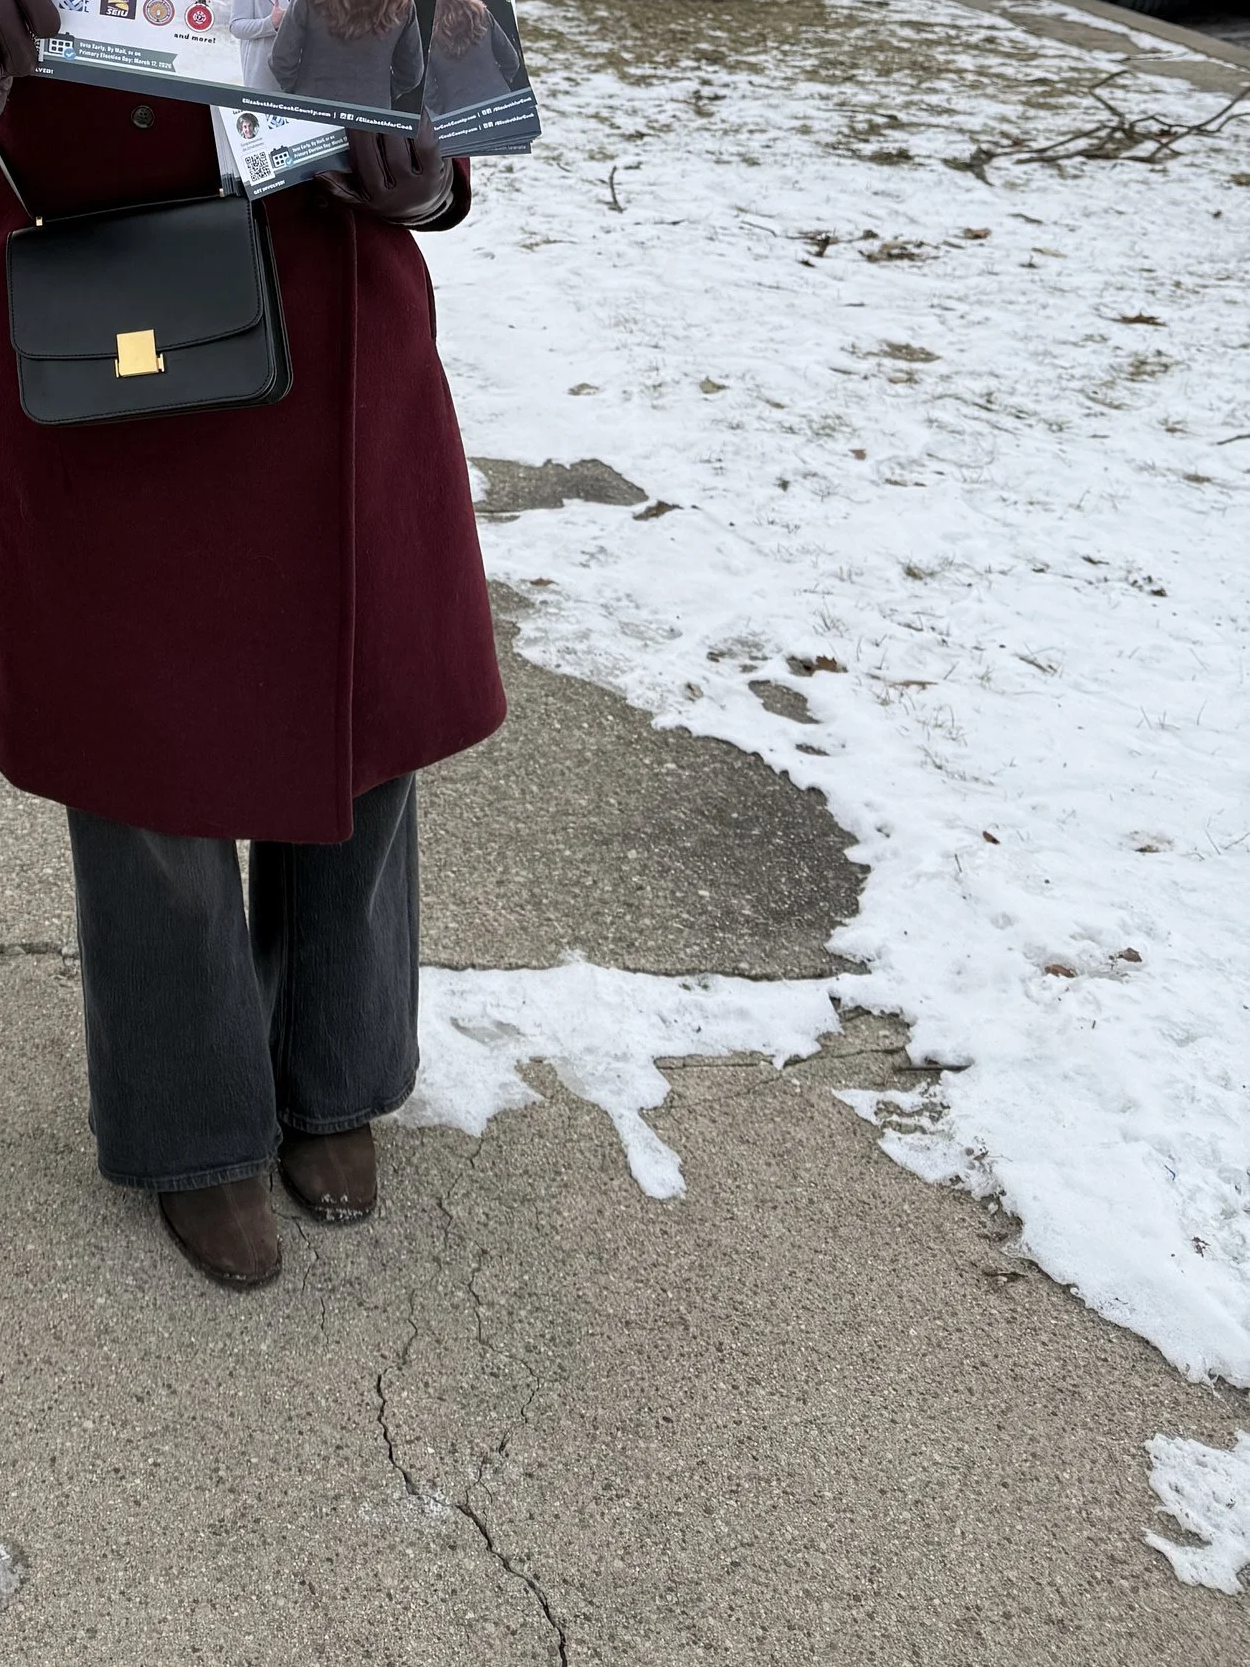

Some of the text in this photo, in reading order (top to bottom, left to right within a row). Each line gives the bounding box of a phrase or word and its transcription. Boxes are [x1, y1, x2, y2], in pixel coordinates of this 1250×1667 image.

[106, 8, 129, 17] SEIU
[191, 35, 216, 44] more!
[78, 49, 99, 58] Primary
